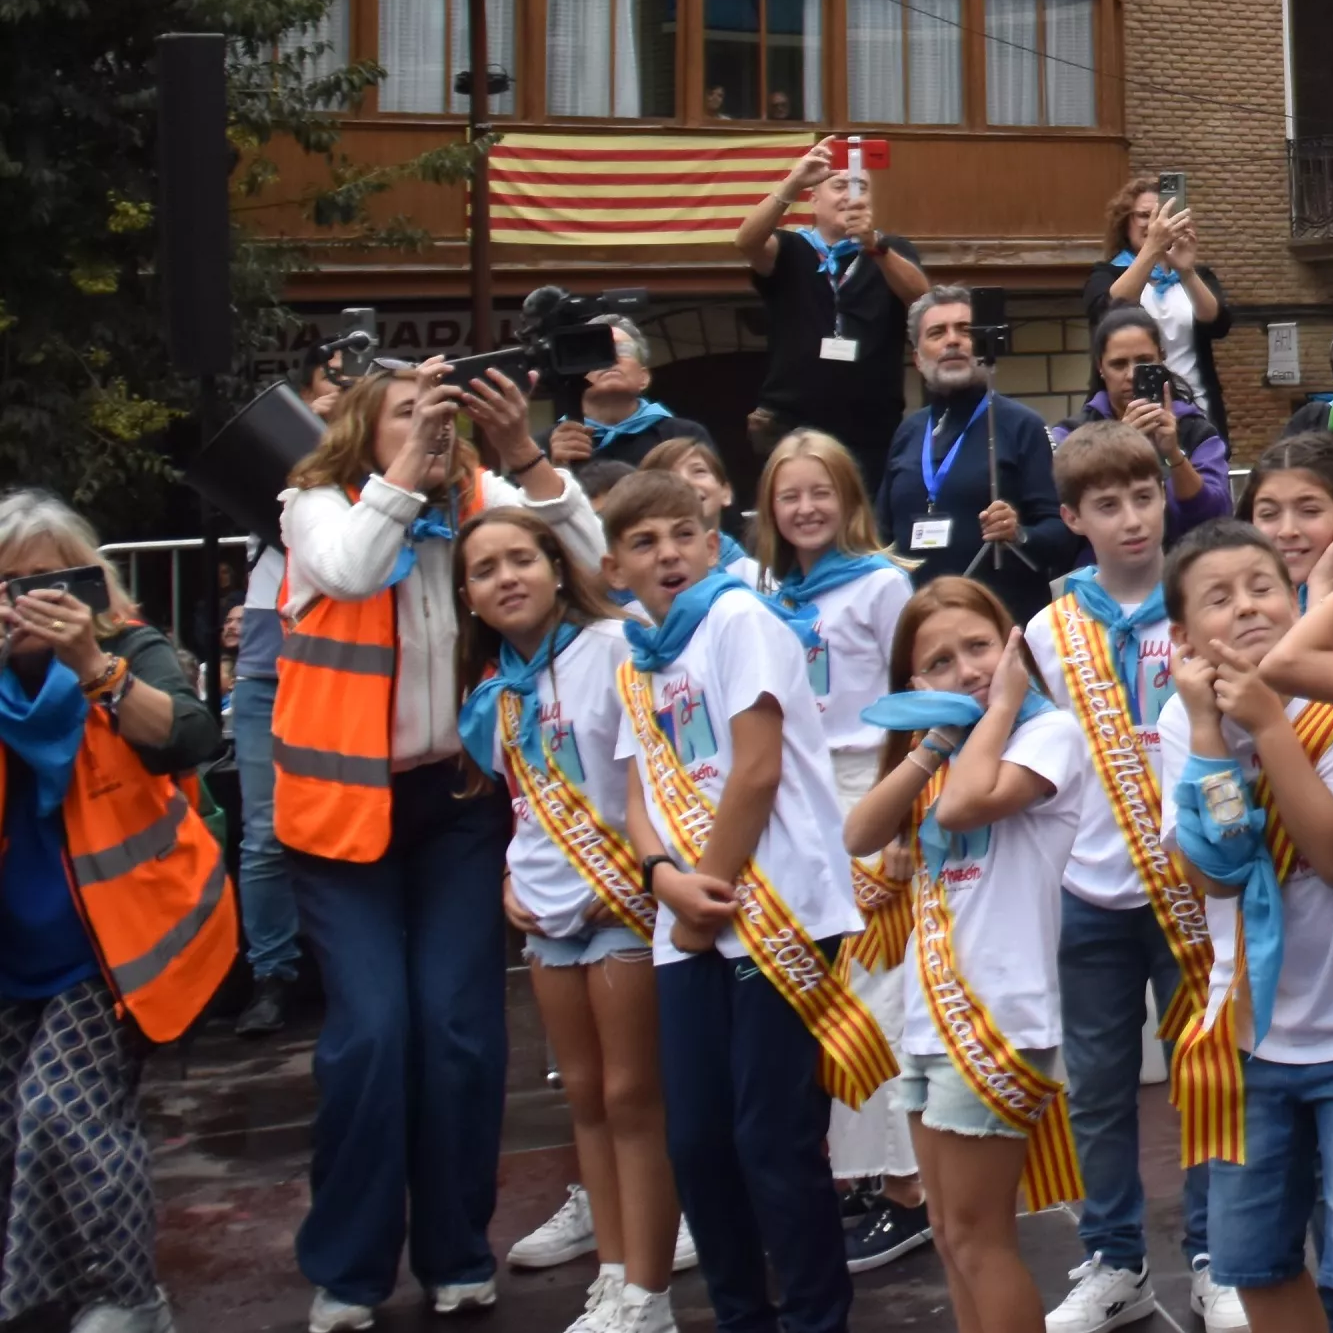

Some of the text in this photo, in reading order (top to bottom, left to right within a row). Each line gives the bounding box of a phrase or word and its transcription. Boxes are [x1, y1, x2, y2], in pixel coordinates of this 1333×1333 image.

[562, 810, 658, 927] Monzón
[1163, 883, 1210, 946] 2024
[762, 928, 824, 992] 2024
[934, 967, 1026, 1109] Monzón
